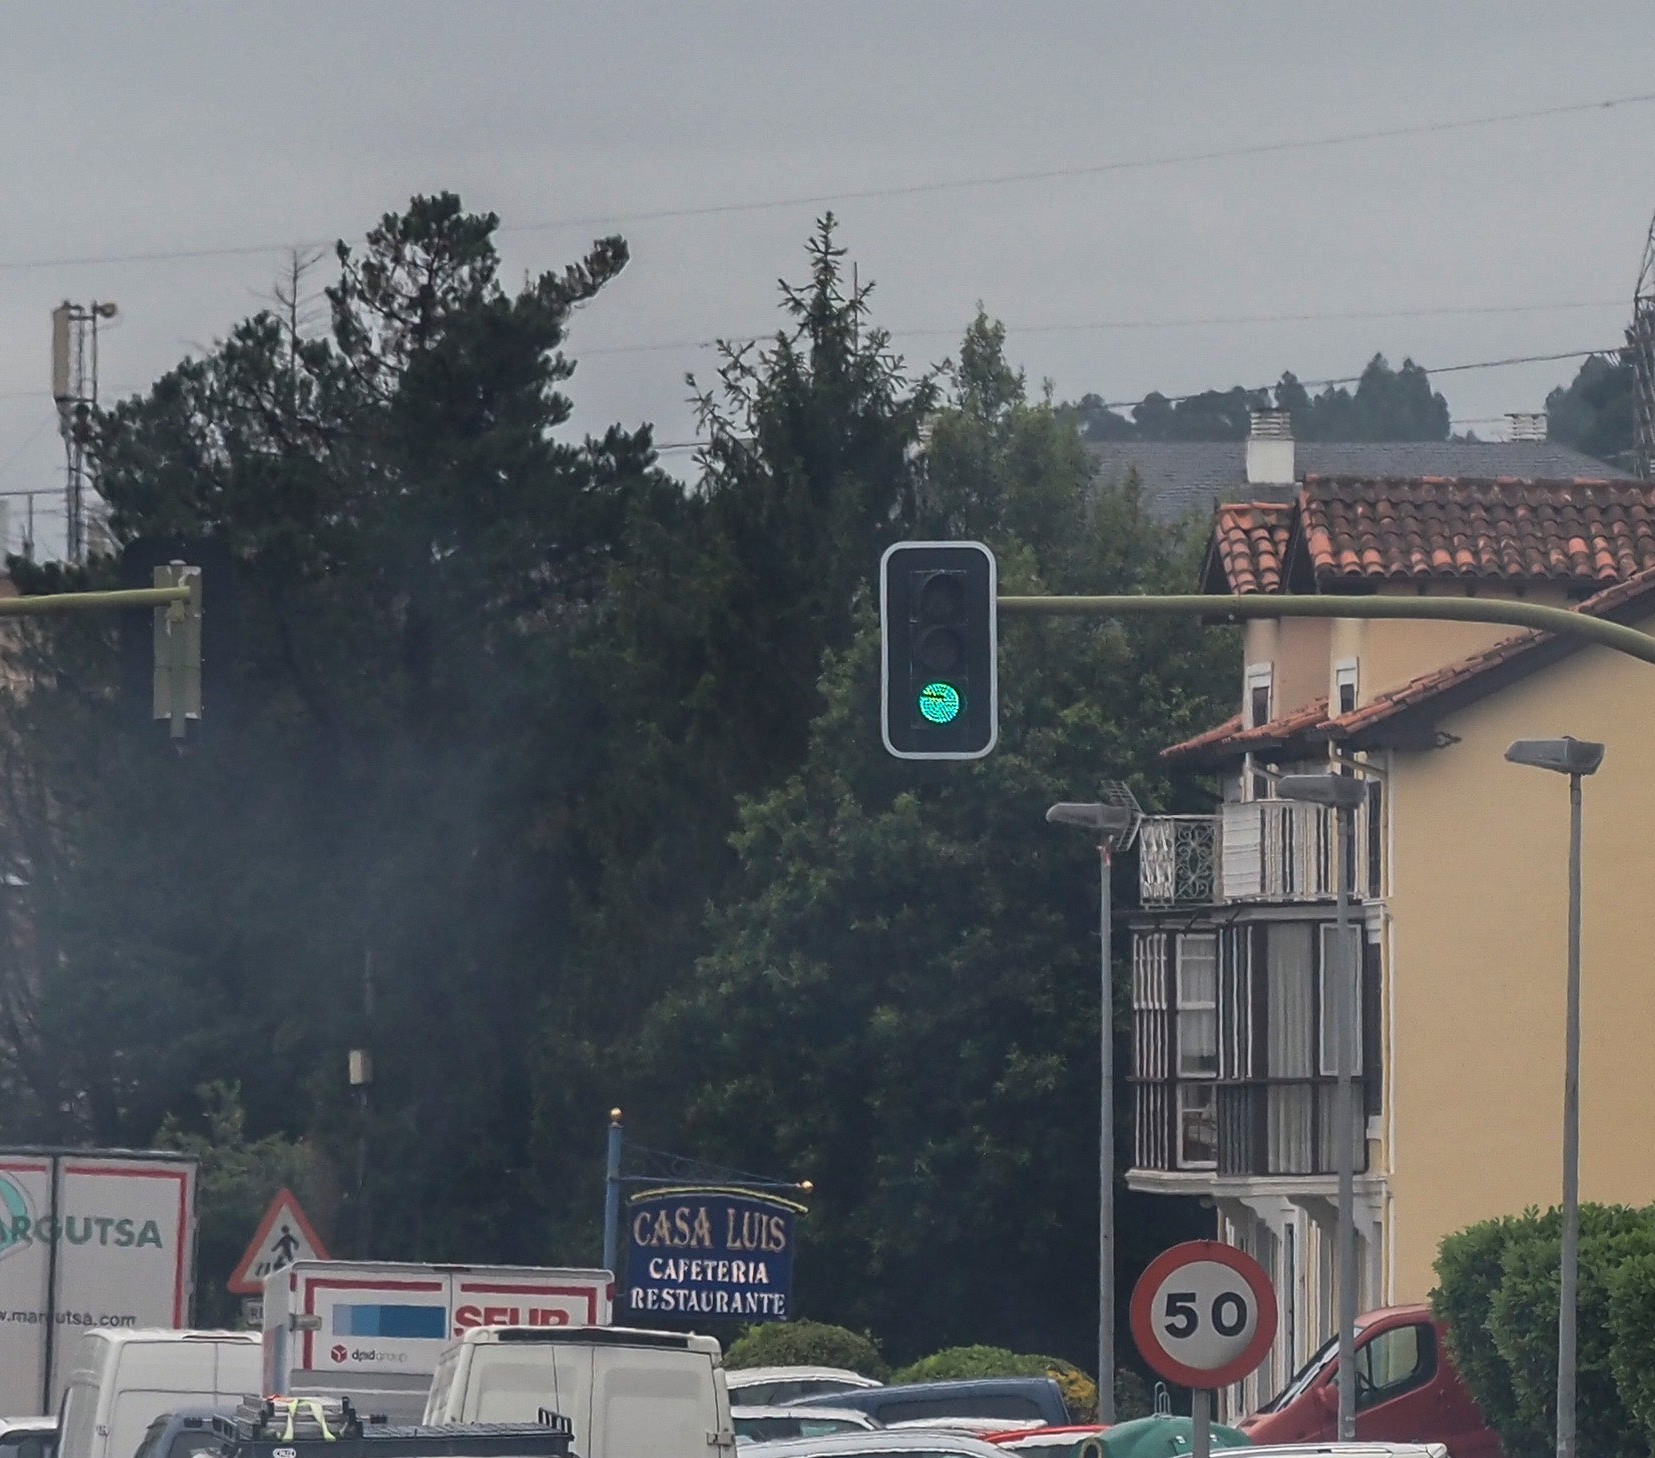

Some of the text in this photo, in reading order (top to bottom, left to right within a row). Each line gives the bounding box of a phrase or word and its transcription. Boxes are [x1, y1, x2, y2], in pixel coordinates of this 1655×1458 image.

[633, 1206, 786, 1253] CASA LUIS
[649, 1257, 770, 1284] CAFETERIA
[630, 1287, 786, 1315] RESTAURANTE
[1164, 1291, 1248, 1339] 50
